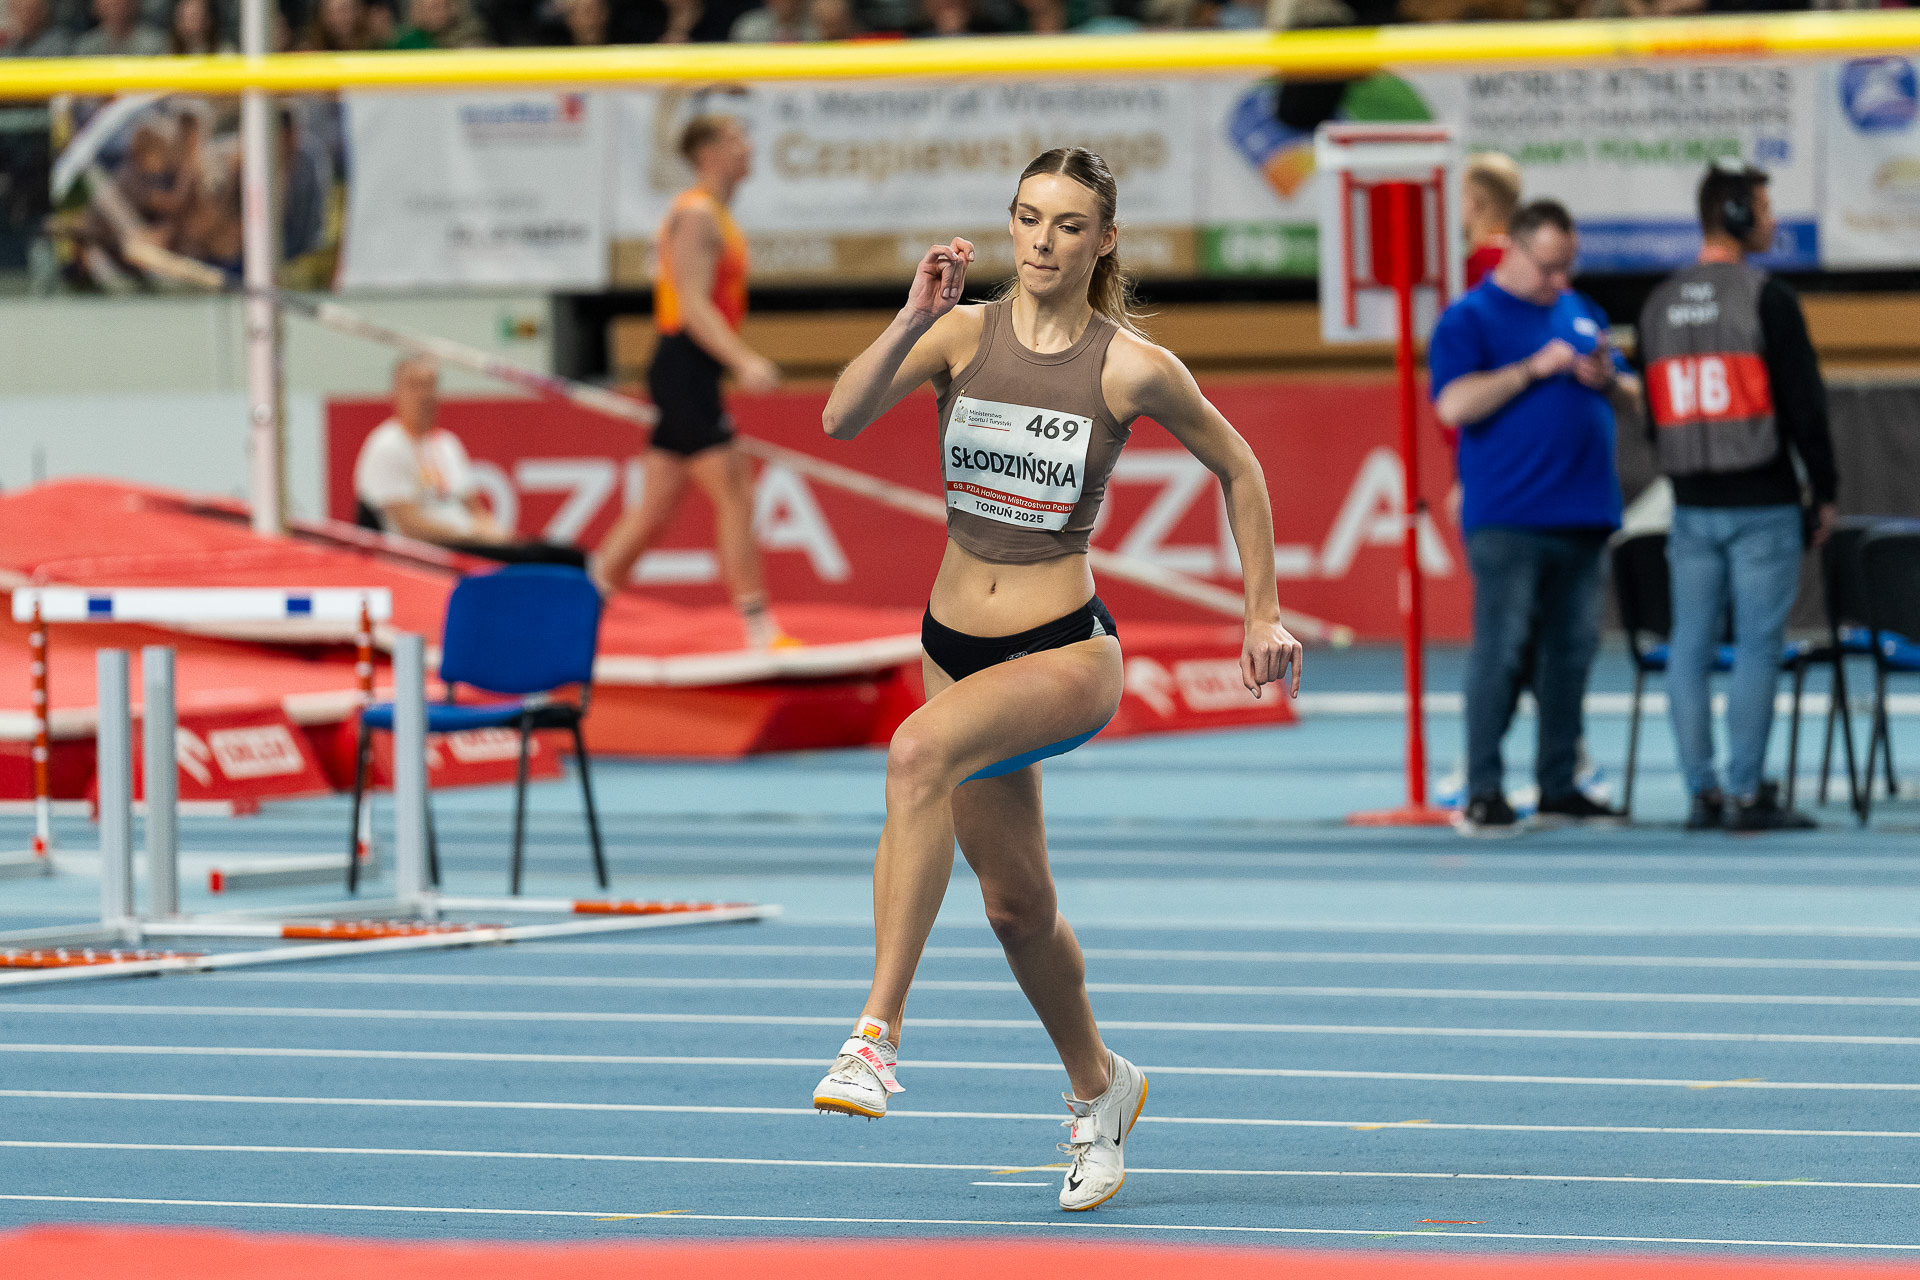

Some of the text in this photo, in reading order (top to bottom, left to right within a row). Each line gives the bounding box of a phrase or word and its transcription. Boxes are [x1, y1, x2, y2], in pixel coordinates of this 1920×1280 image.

[968, 415, 986, 423] Sportu
[989, 418, 1012, 427] Turystyki
[969, 409, 1003, 419] Ministerstwo
[1025, 414, 1079, 442] 469
[951, 445, 1077, 489] SŁODZIŃSKA
[953, 482, 1074, 513] 69. PZLA Halowe Mistrzostwa Polsk
[975, 500, 1045, 524] TORUŃ 2025
[1092, 446, 1453, 578] ZLA
[857, 1046, 885, 1073] NIKE
